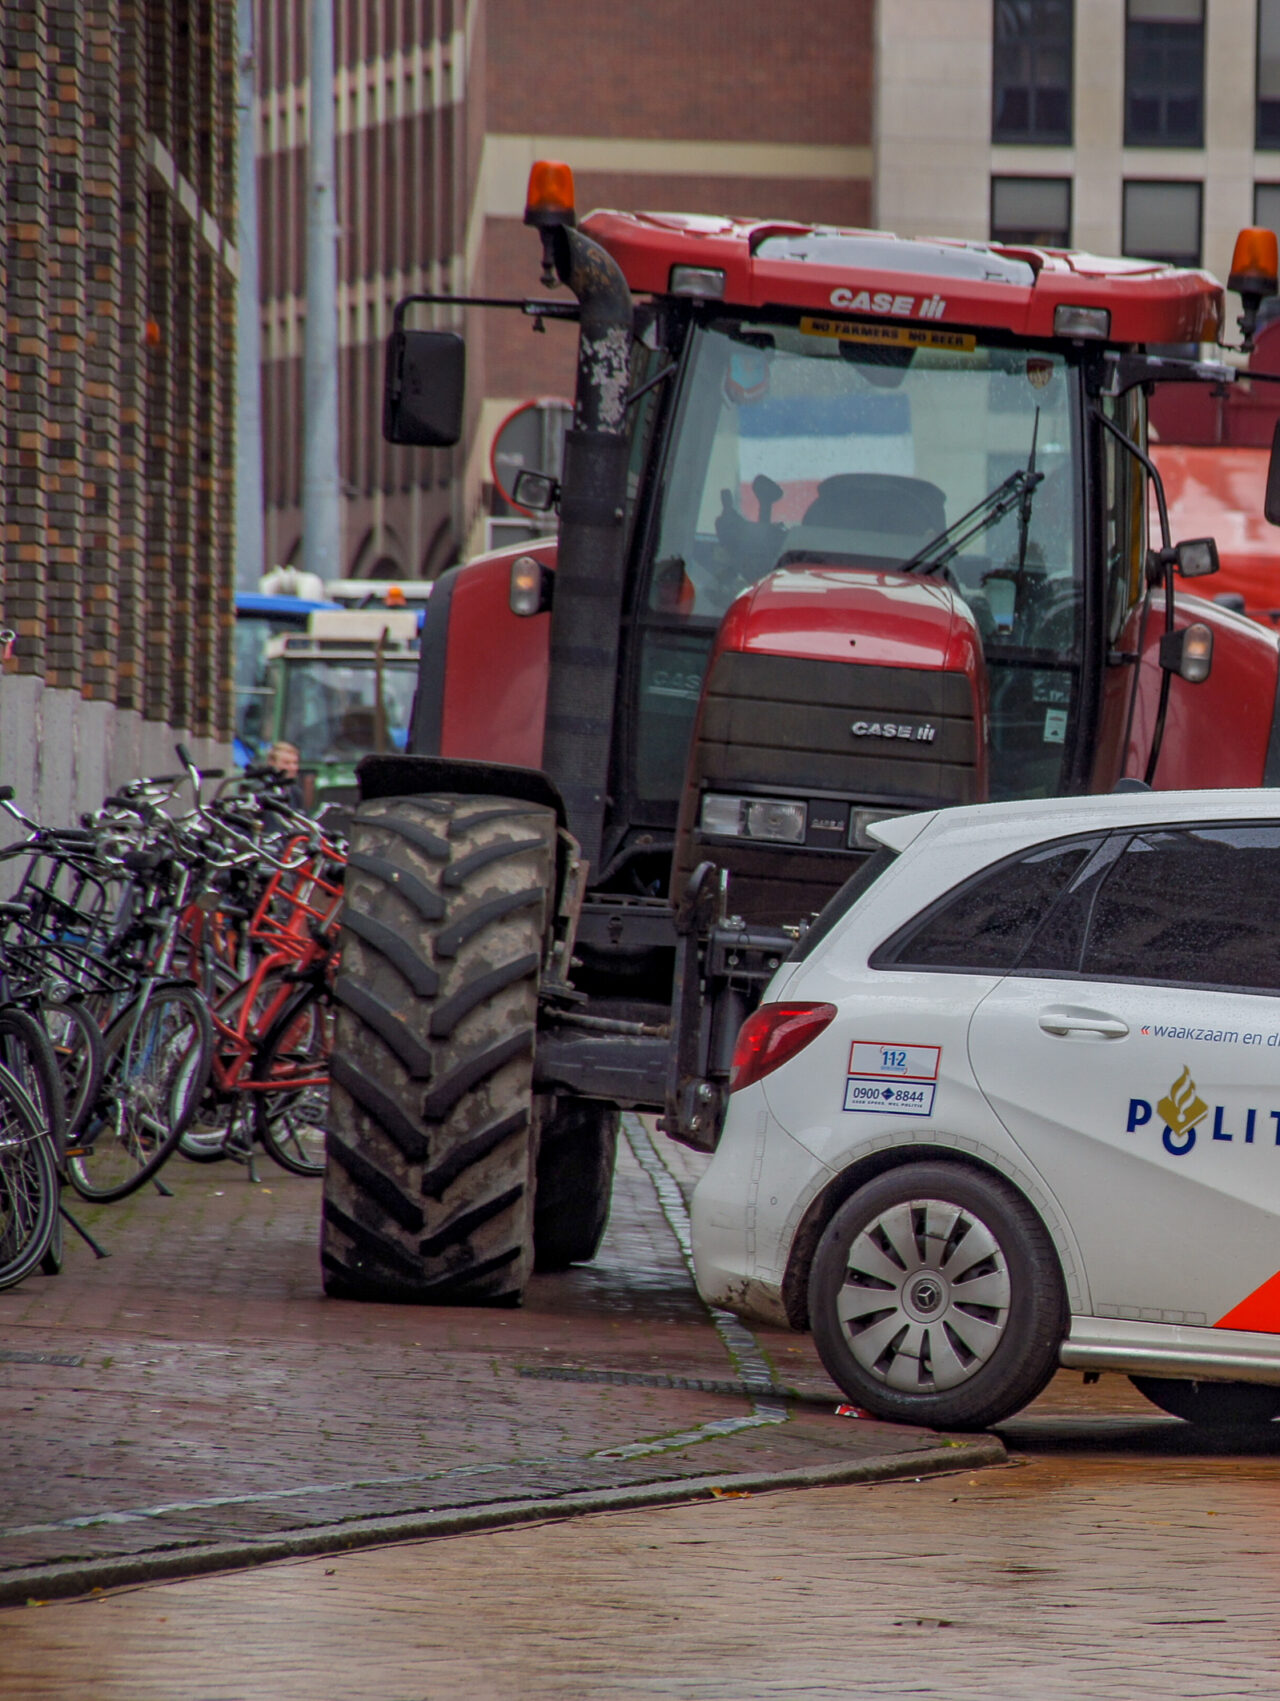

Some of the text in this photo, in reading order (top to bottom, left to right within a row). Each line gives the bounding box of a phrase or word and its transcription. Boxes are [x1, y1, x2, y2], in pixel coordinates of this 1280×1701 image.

[829, 287, 915, 316] CASE
[811, 321, 830, 333] NO
[834, 323, 899, 339] FARMERS
[908, 331, 927, 343] NO
[851, 721, 912, 739] CASE
[1153, 1024, 1239, 1044] waakzaam
[1242, 1032, 1262, 1046] en
[853, 1087, 924, 1102] 0900 8844
